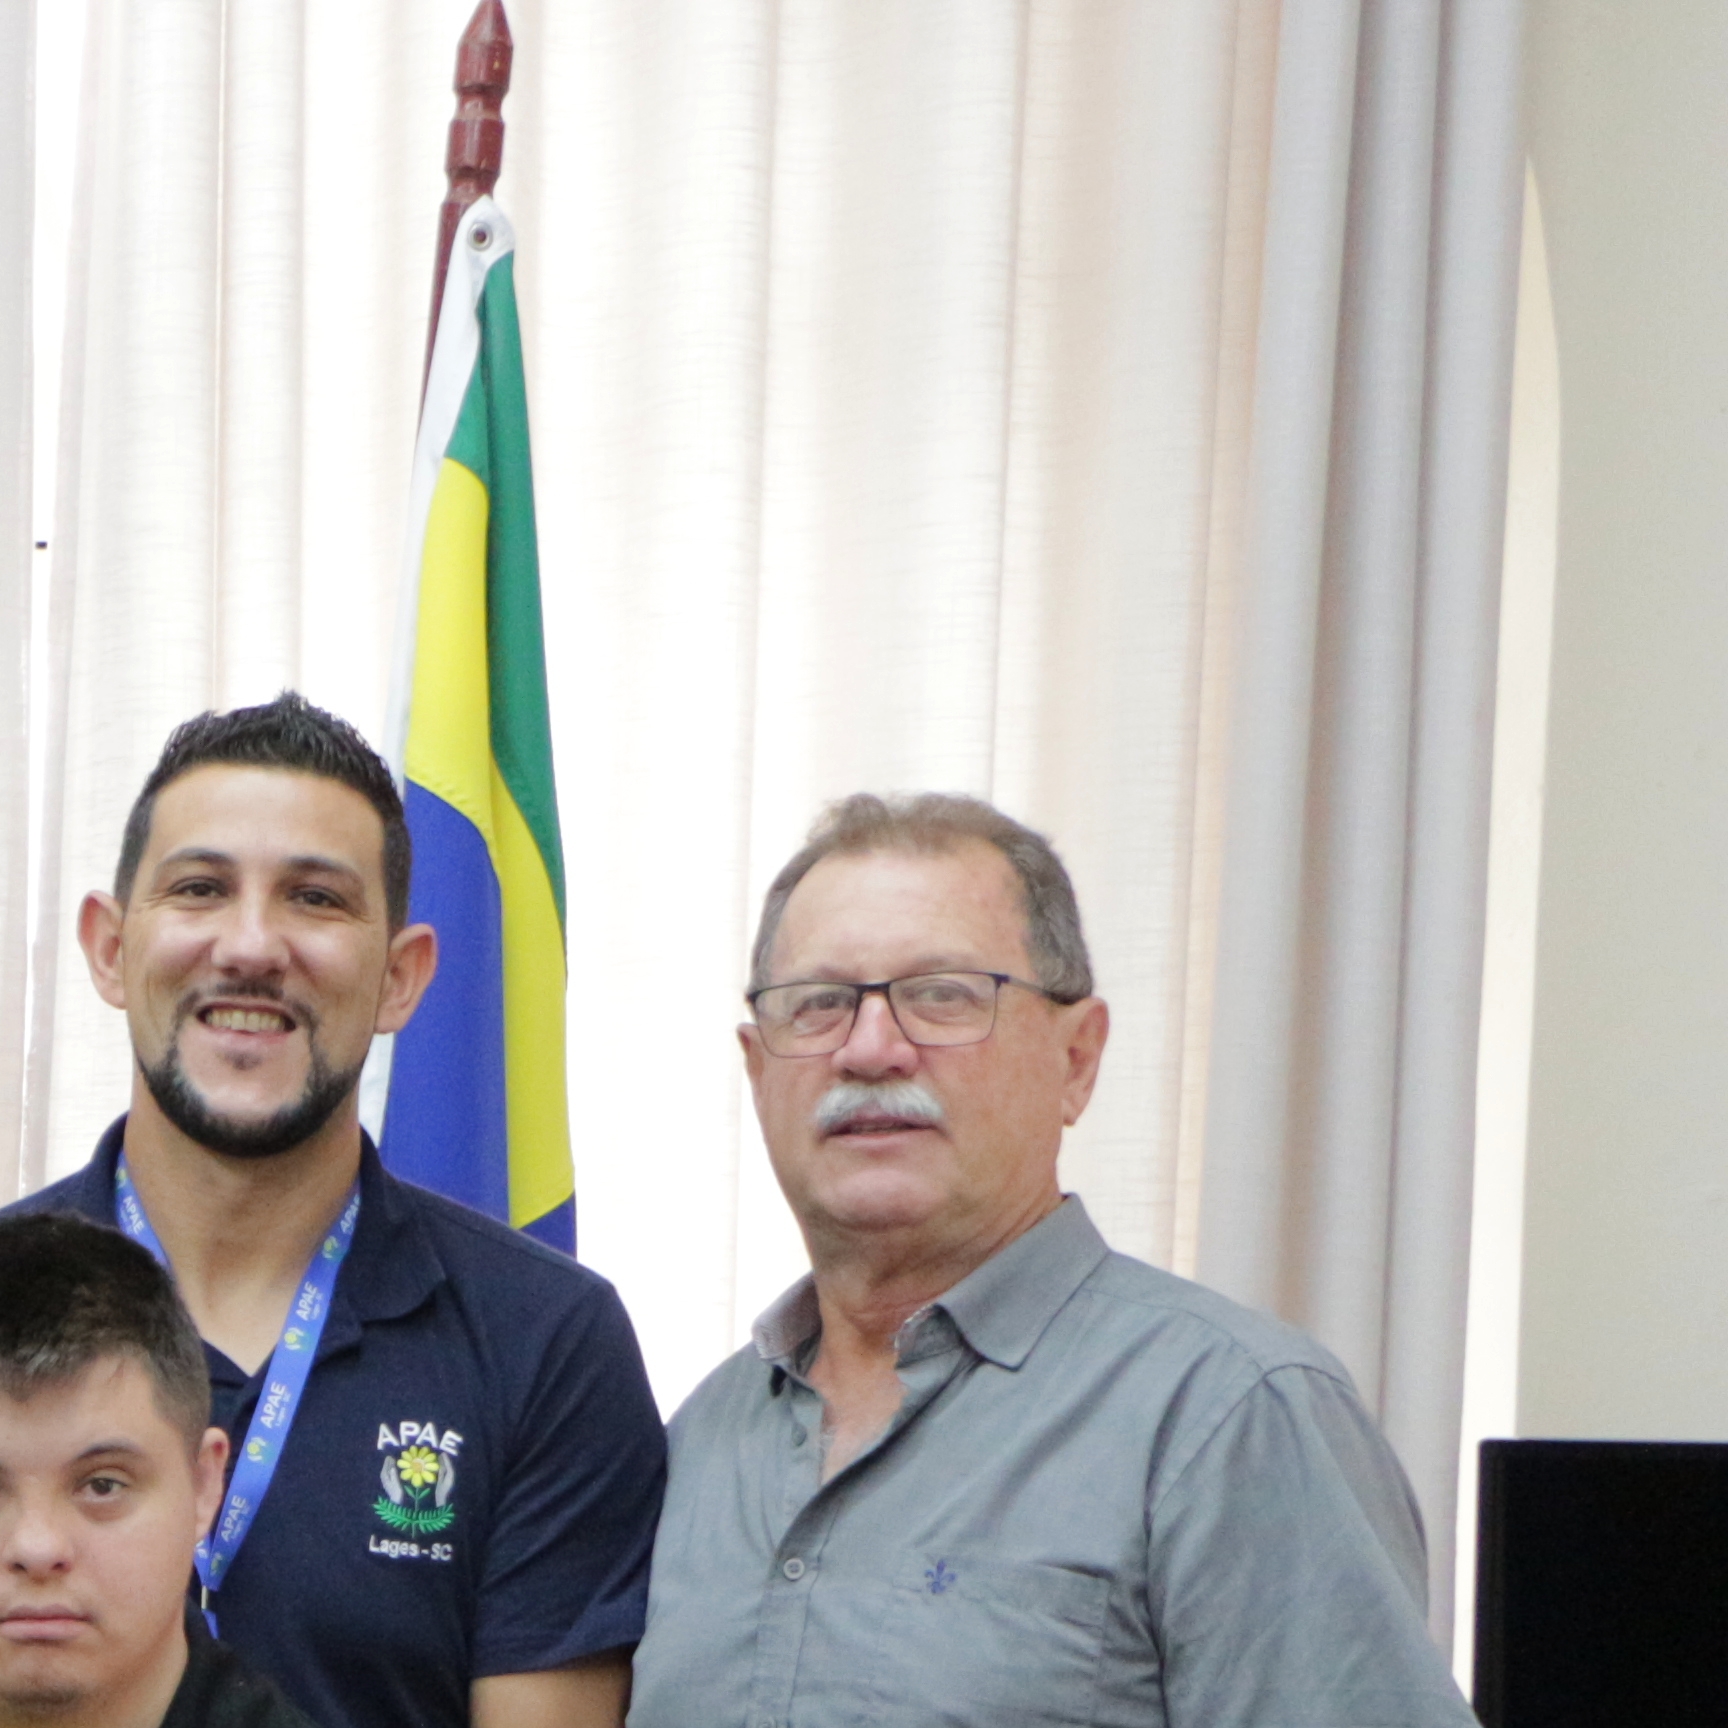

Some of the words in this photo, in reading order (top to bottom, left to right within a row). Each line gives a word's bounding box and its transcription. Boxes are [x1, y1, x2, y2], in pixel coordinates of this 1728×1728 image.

[122, 1195, 144, 1236] APAE
[295, 1281, 319, 1321] APAE
[259, 1381, 287, 1429] APAE
[377, 1421, 464, 1457] APAE
[220, 1494, 247, 1543] APAE
